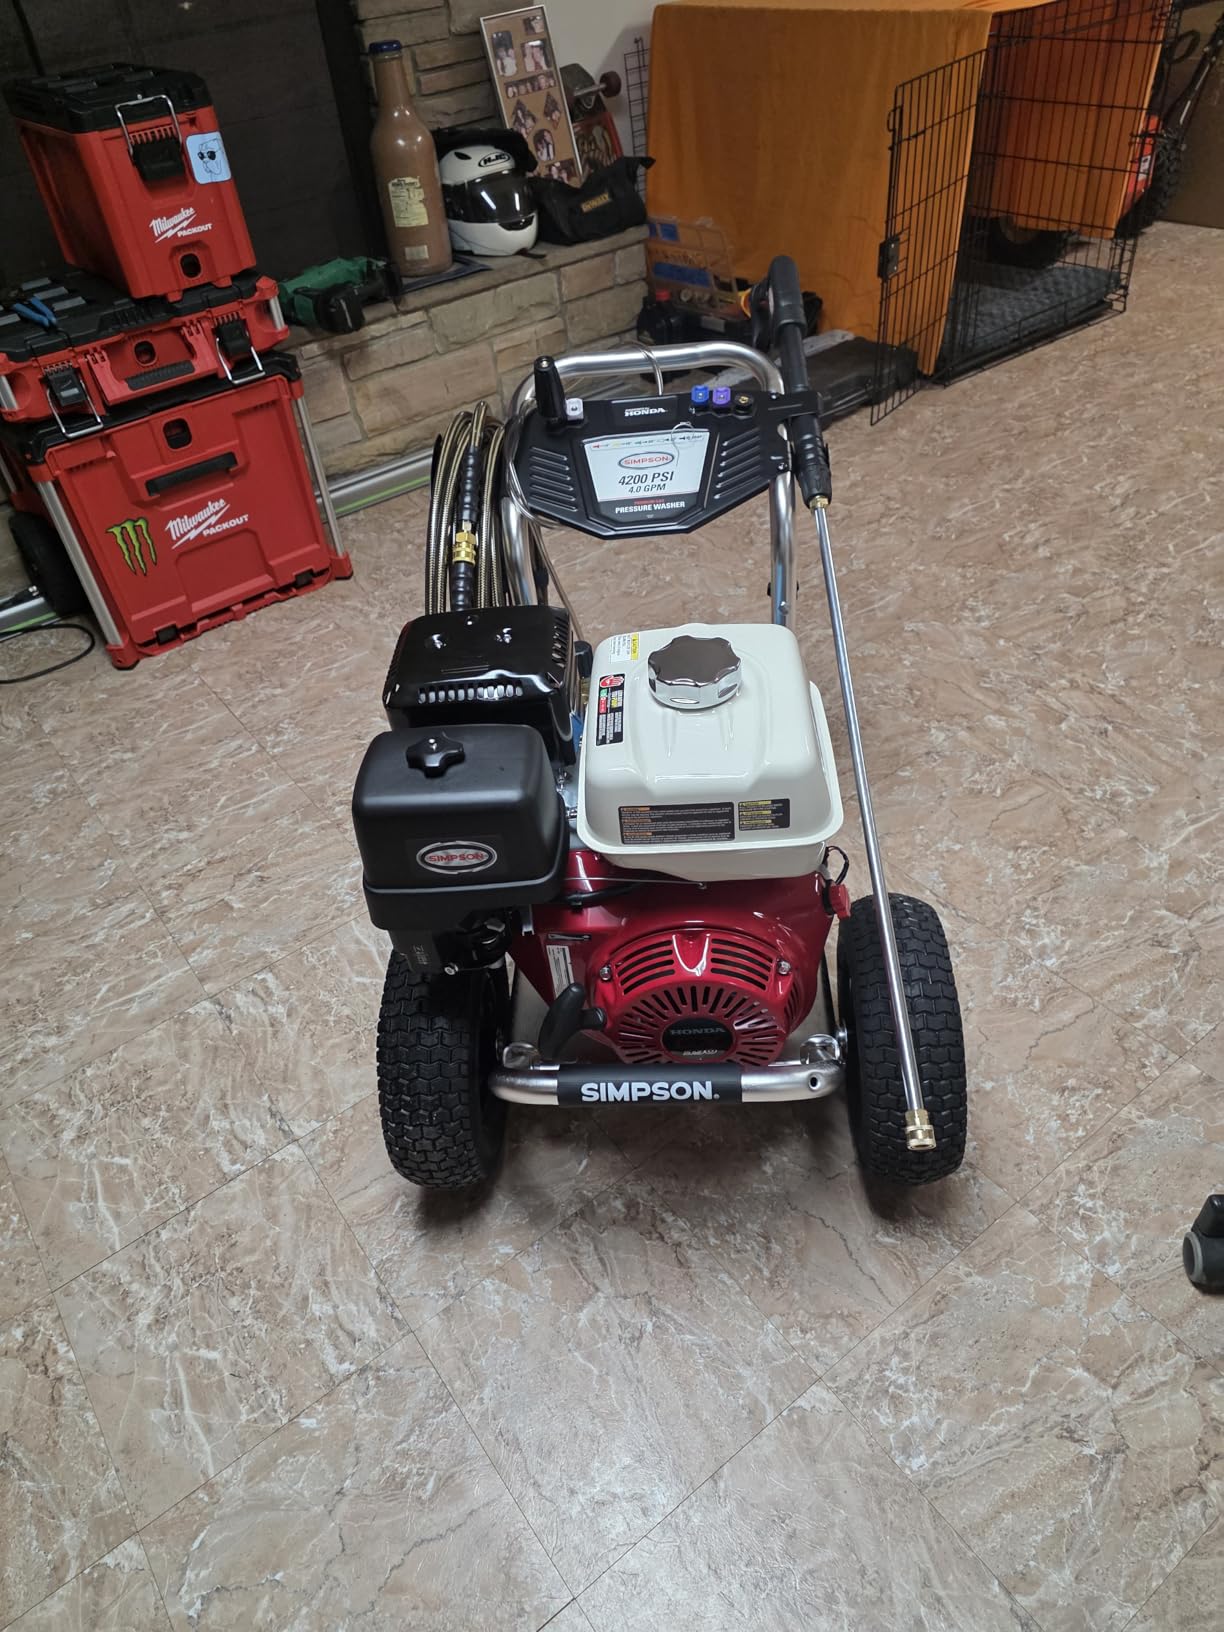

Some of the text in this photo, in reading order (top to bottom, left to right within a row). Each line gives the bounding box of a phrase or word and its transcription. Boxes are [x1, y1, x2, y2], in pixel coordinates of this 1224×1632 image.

[149, 207, 195, 237] Milwaukee
[177, 223, 212, 237] PACKOUT
[624, 407, 667, 417] HONDA
[623, 456, 669, 466] SIMPSON
[618, 471, 674, 486] 4200 PSI
[628, 483, 666, 494] 4.0 GPM
[615, 503, 652, 514] PRESSURE
[653, 501, 685, 511] WASHER
[165, 498, 226, 541] Milwaukee
[202, 513, 249, 537] PACKOUT
[428, 852, 485, 863] SIMPSON
[669, 1027, 726, 1036] HONDA
[580, 1080, 713, 1102] SIMPSON
